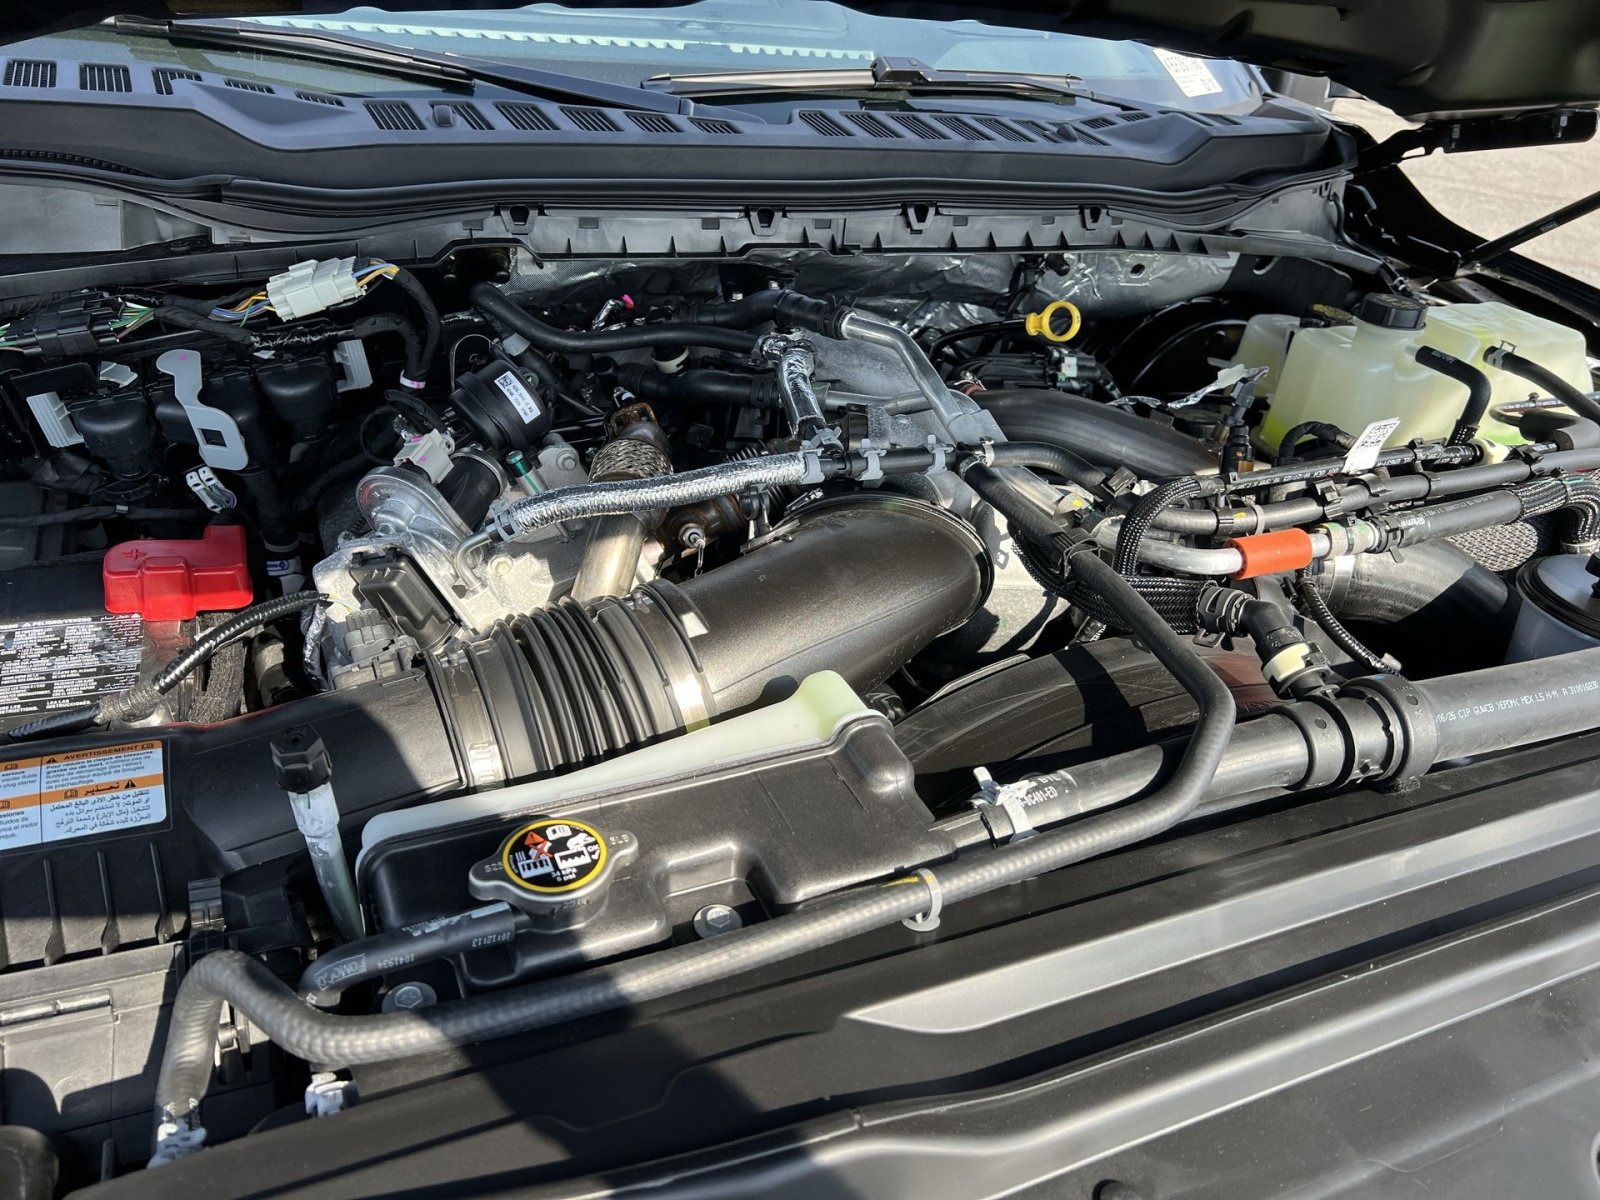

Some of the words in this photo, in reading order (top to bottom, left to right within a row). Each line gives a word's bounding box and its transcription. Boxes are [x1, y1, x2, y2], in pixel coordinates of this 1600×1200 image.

[1521, 696, 1534, 705] MEX
[64, 746, 138, 760] AVERTISSEMENT
[46, 768, 68, 776] graves
[109, 794, 120, 802] خطر
[20, 822, 38, 830] motor
[587, 844, 600, 853] OK
